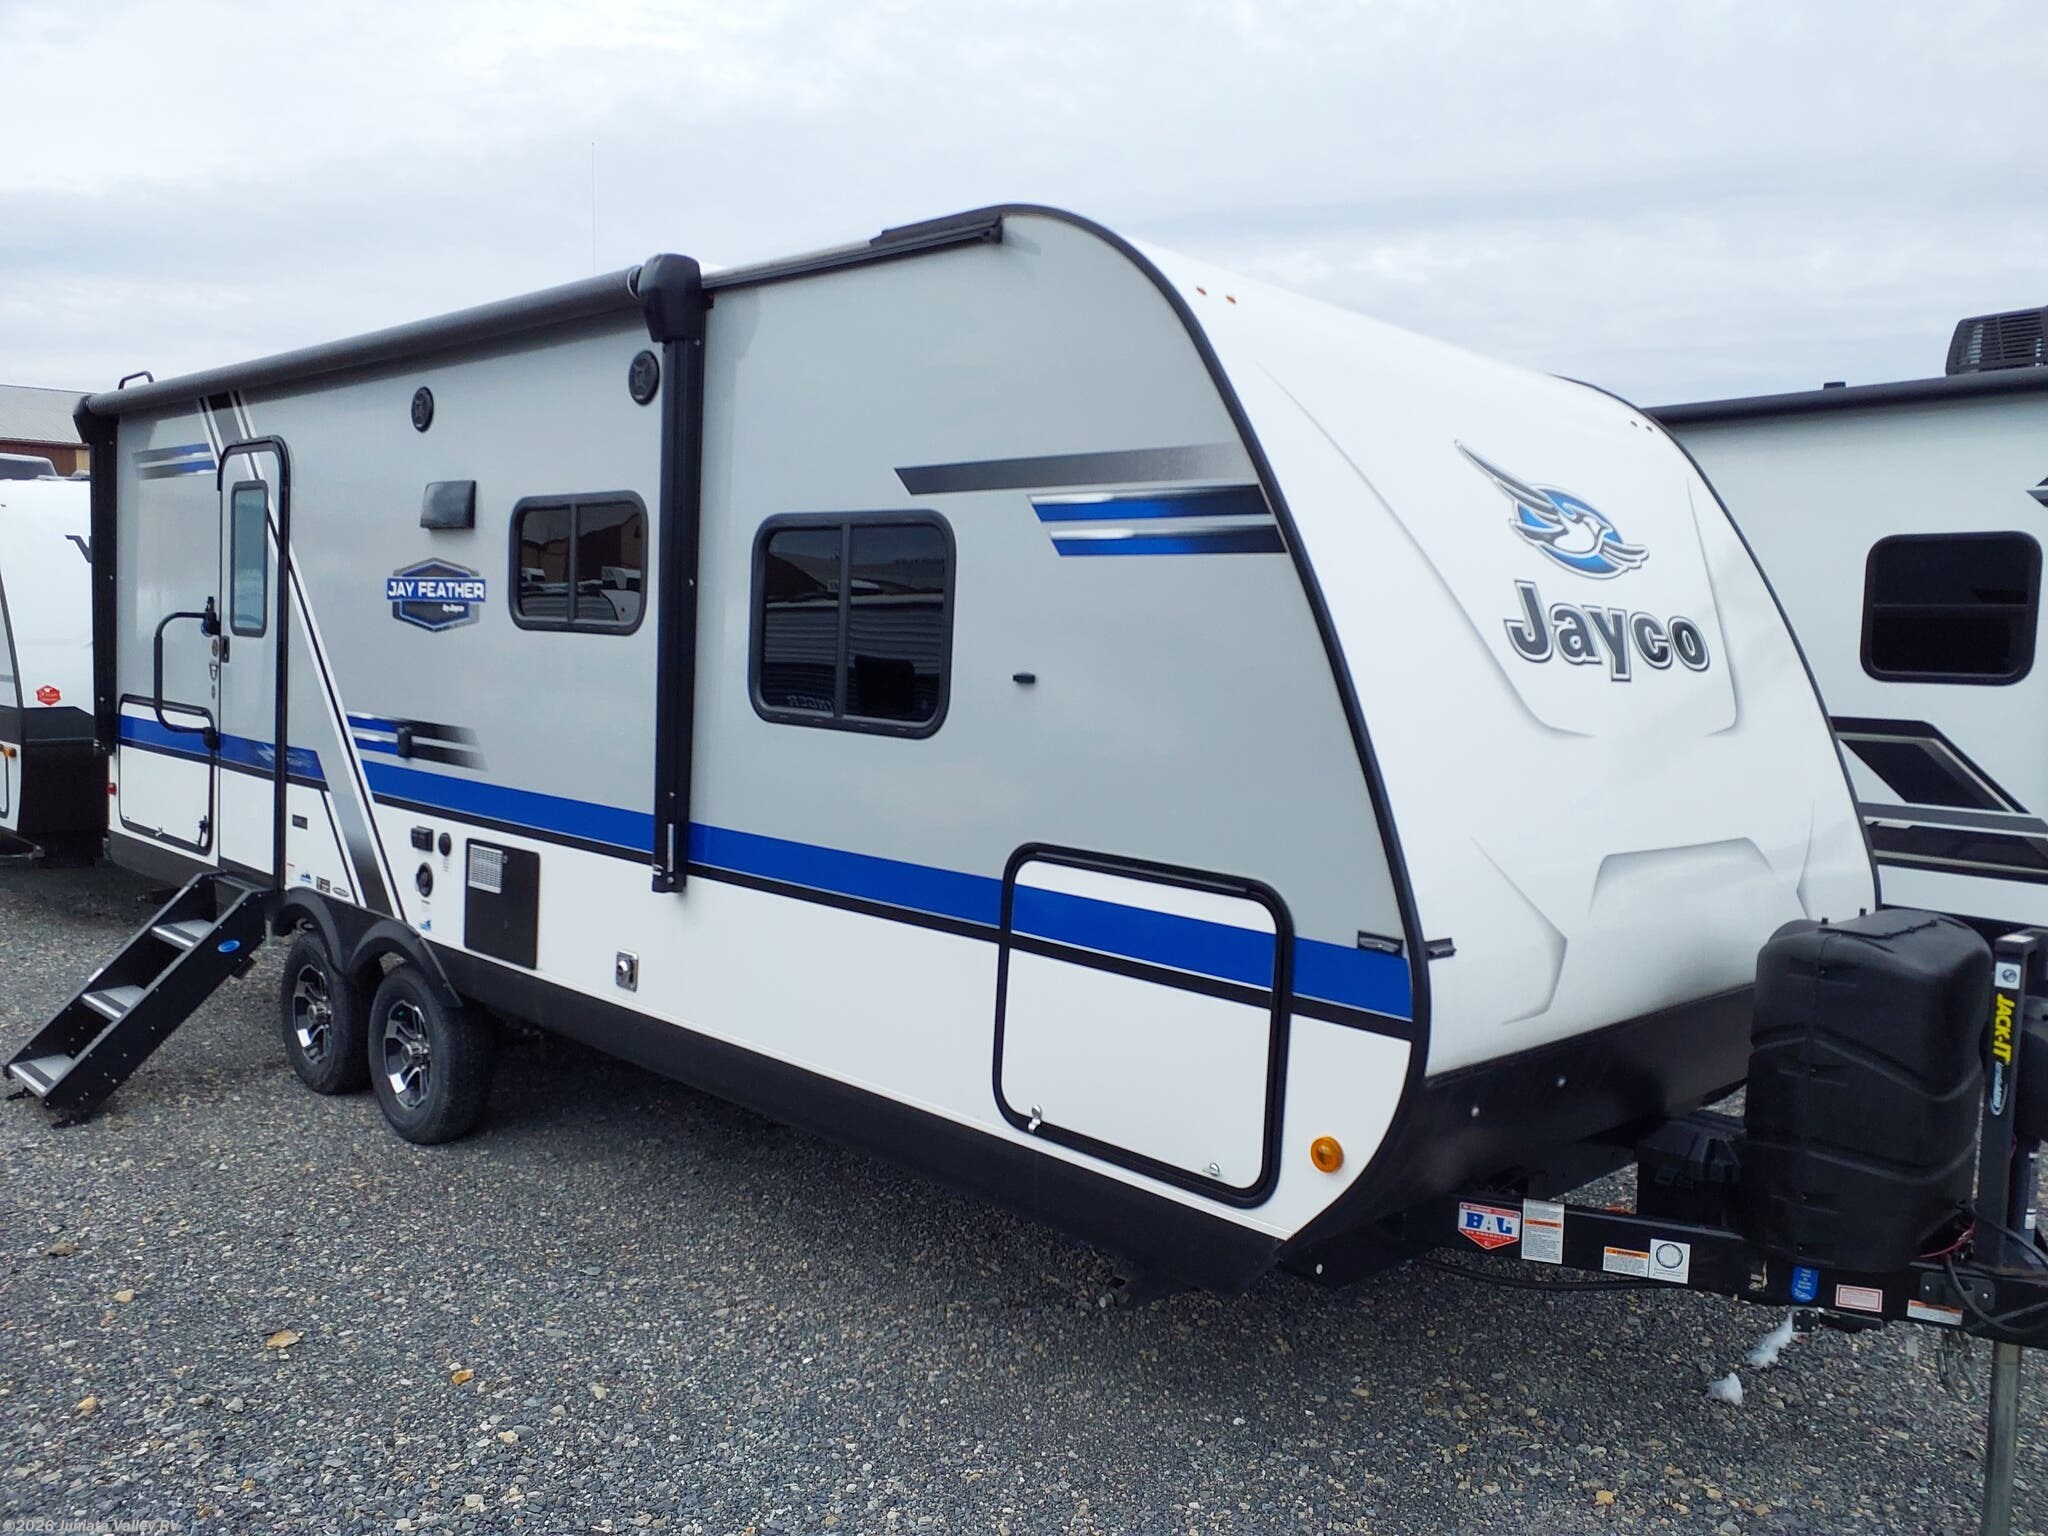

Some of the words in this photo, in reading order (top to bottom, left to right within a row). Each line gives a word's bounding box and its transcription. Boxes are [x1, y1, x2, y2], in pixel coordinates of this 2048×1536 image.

[388, 581, 415, 597] JAY
[418, 581, 485, 599] FEATHER
[1504, 579, 1710, 682] Jayco
[1992, 993, 2015, 1065] JACK-IT
